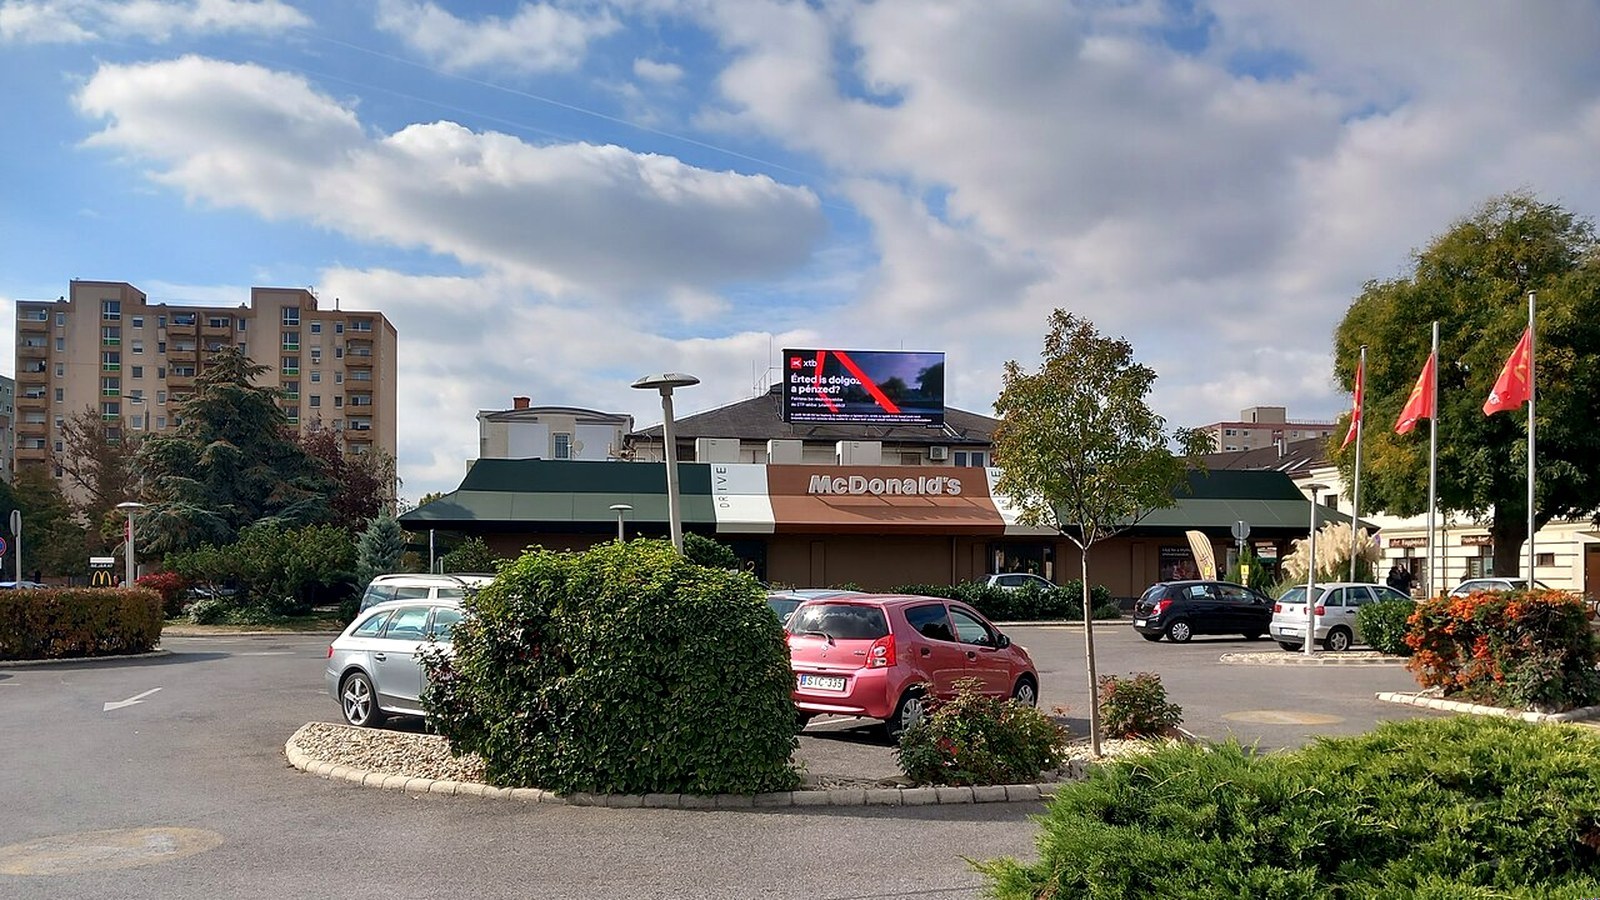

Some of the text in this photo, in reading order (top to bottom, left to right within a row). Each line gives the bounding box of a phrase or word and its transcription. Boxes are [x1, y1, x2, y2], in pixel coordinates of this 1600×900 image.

[791, 373, 818, 384] Érted
[819, 375, 827, 384] is
[798, 384, 841, 395] pénzed?
[716, 467, 730, 509] DRIVE
[809, 475, 962, 495] McDonald's
